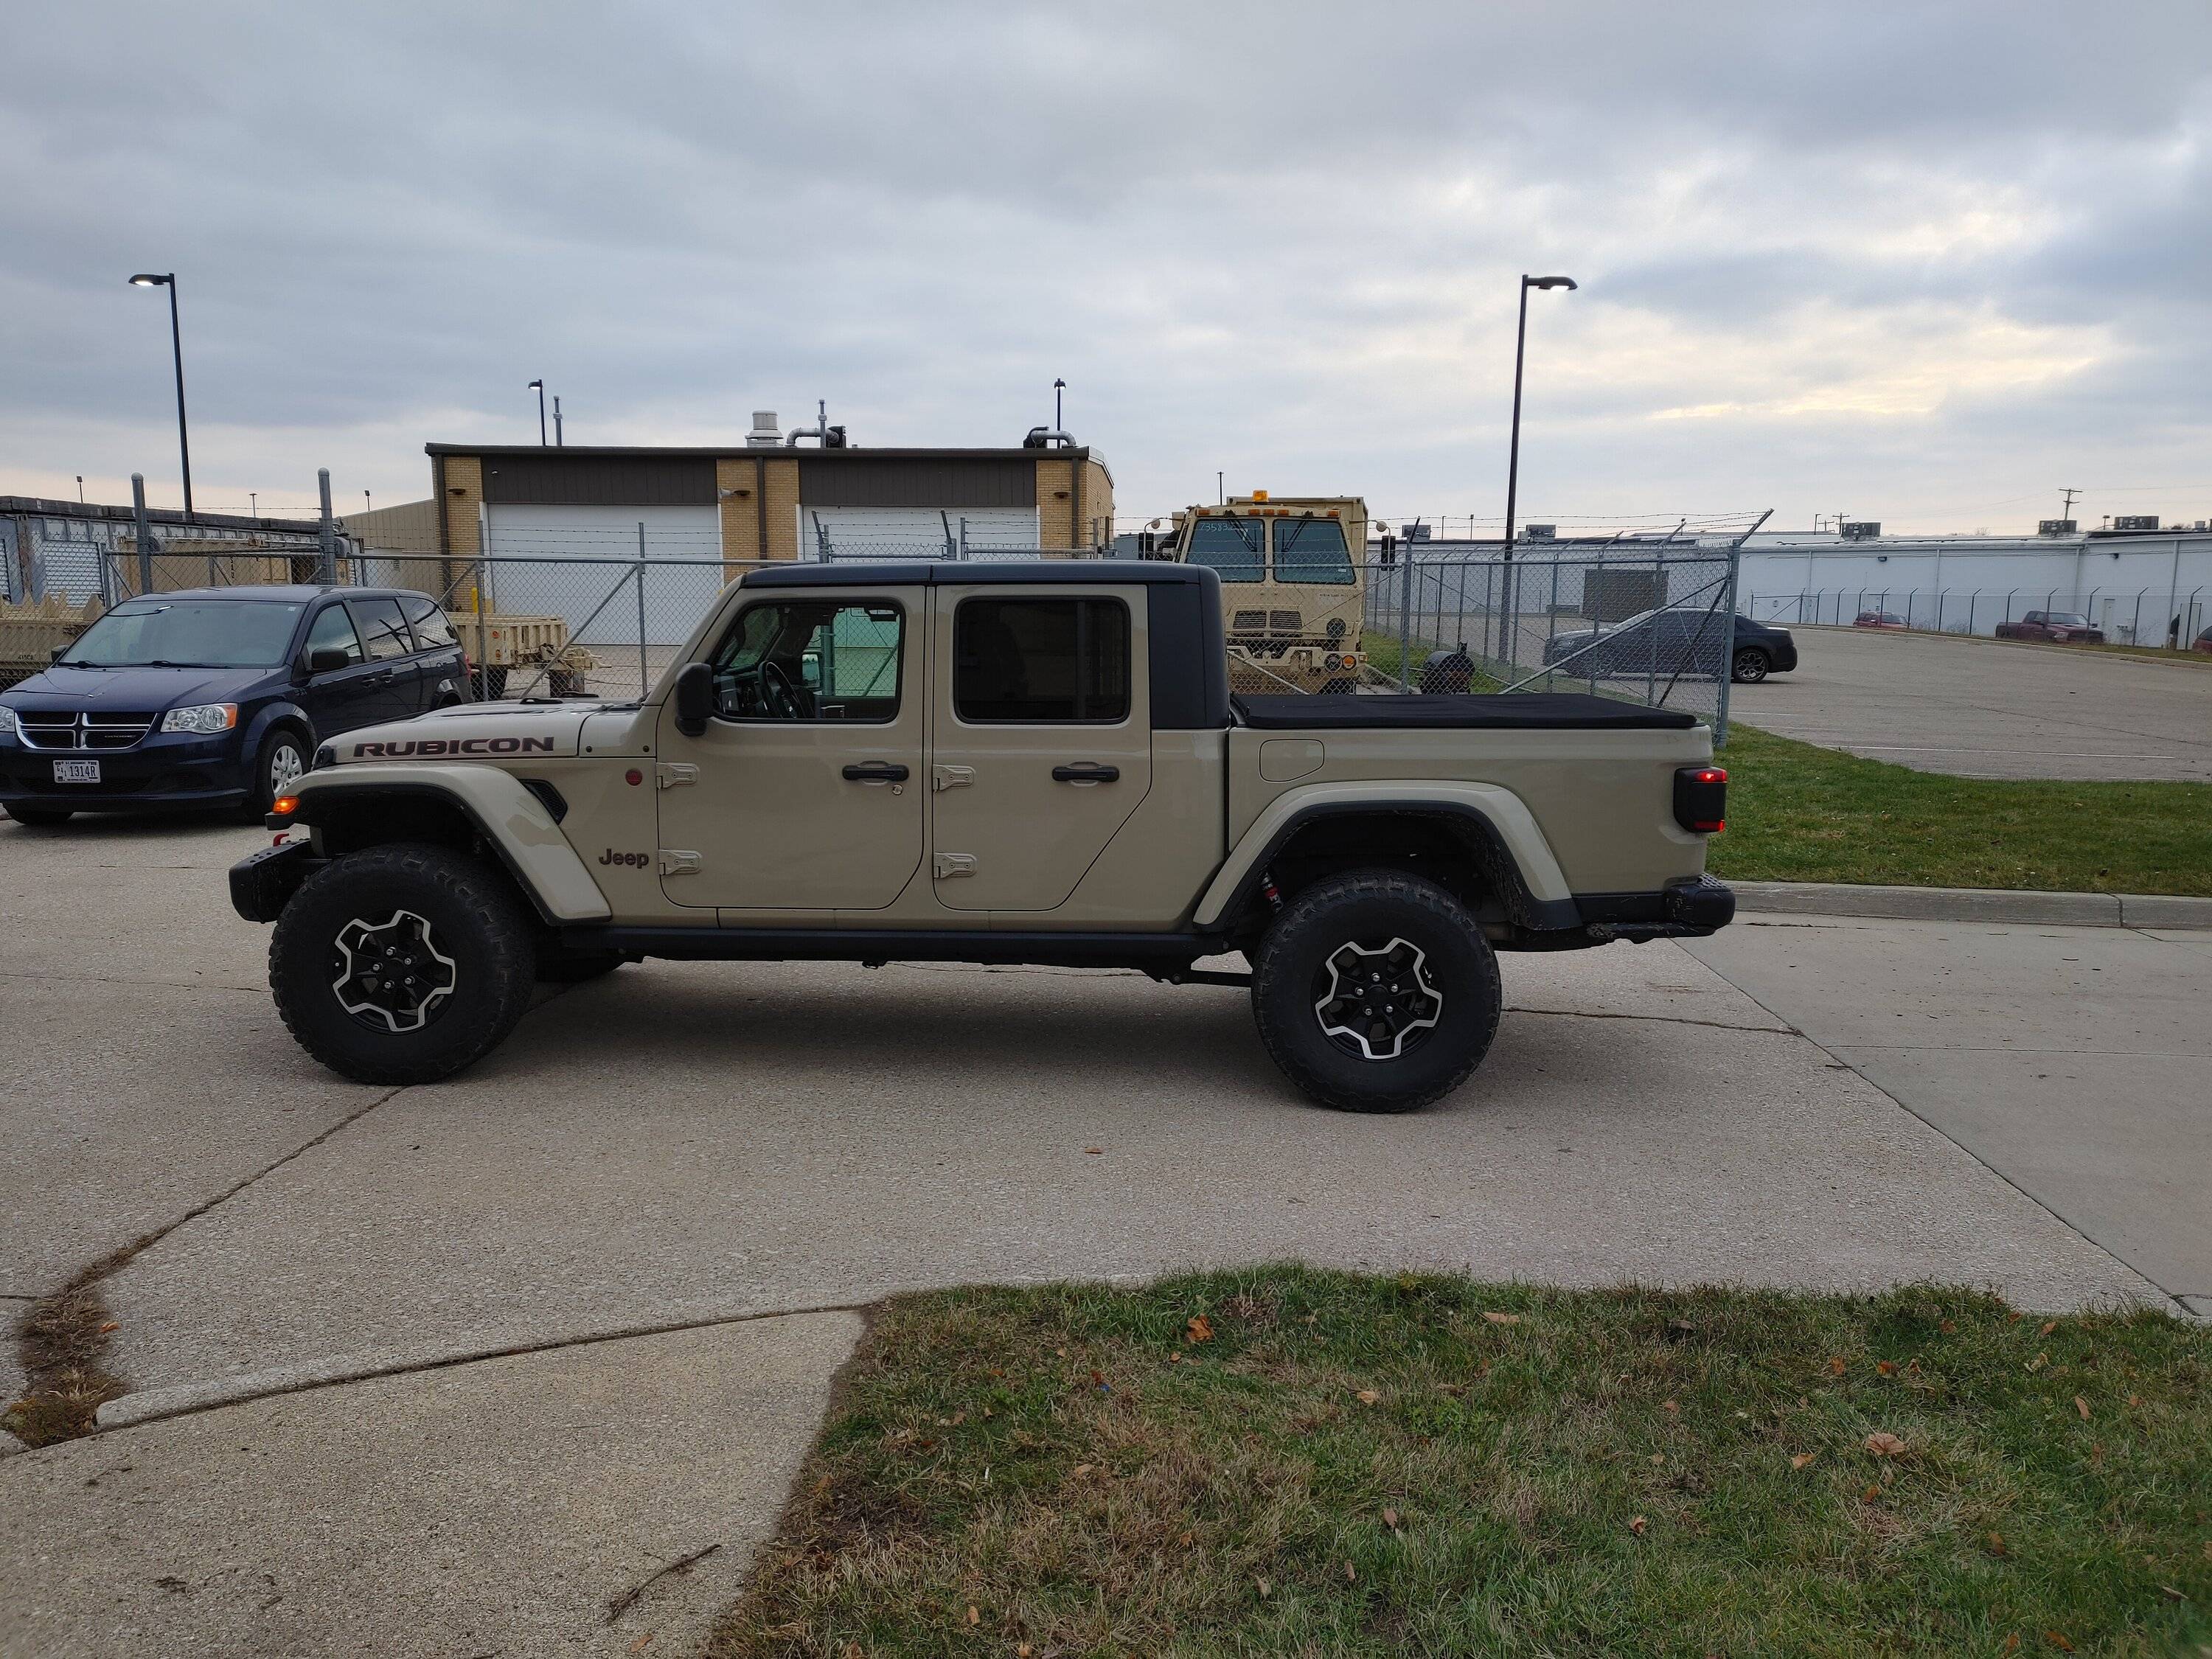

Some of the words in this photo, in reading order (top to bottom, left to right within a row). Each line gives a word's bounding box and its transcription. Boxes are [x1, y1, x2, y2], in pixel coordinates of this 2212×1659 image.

[353, 737, 554, 757] RUBICON
[70, 766, 96, 776] 1314R
[599, 849, 649, 869] Jeep
